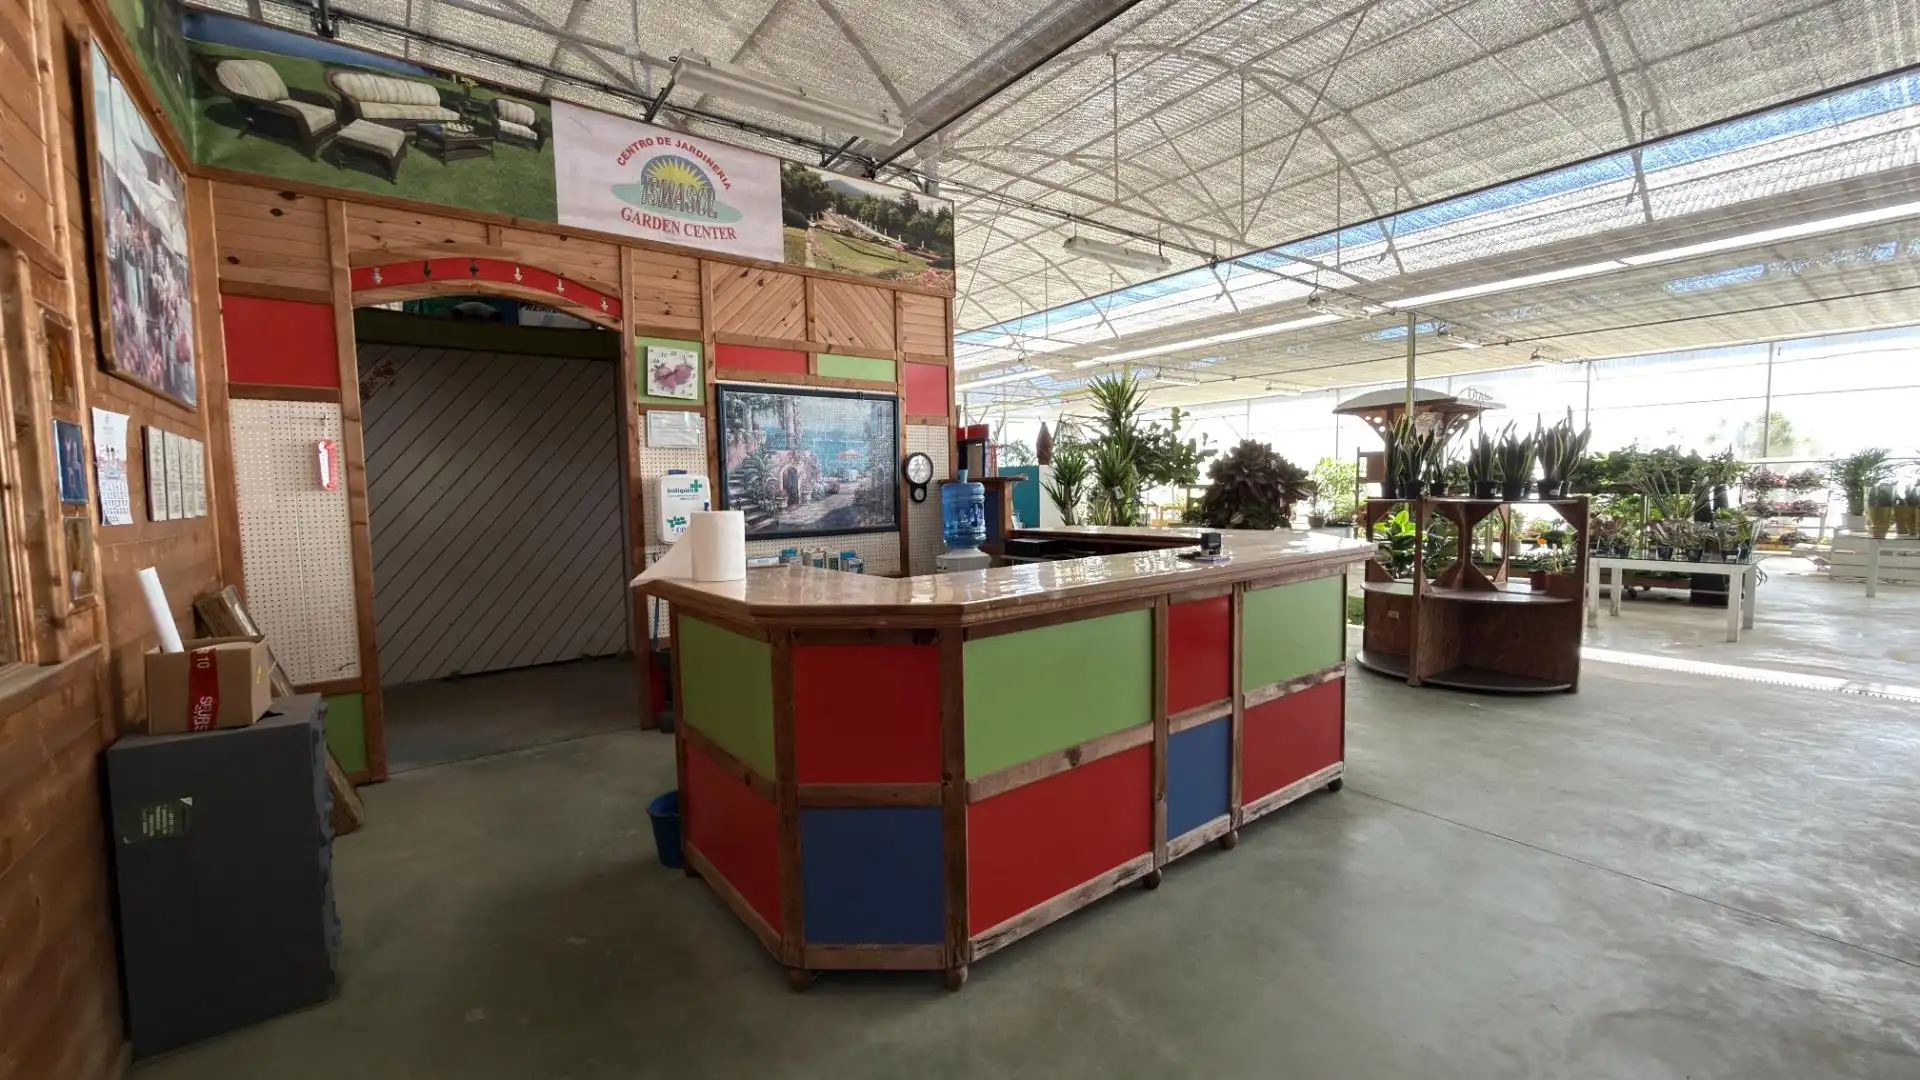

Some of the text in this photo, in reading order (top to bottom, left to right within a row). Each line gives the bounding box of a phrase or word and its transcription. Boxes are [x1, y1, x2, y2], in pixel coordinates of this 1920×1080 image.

[617, 137, 654, 166] CENTRO
[656, 136, 672, 146] DE
[621, 207, 737, 240] GARDEN CENTER
